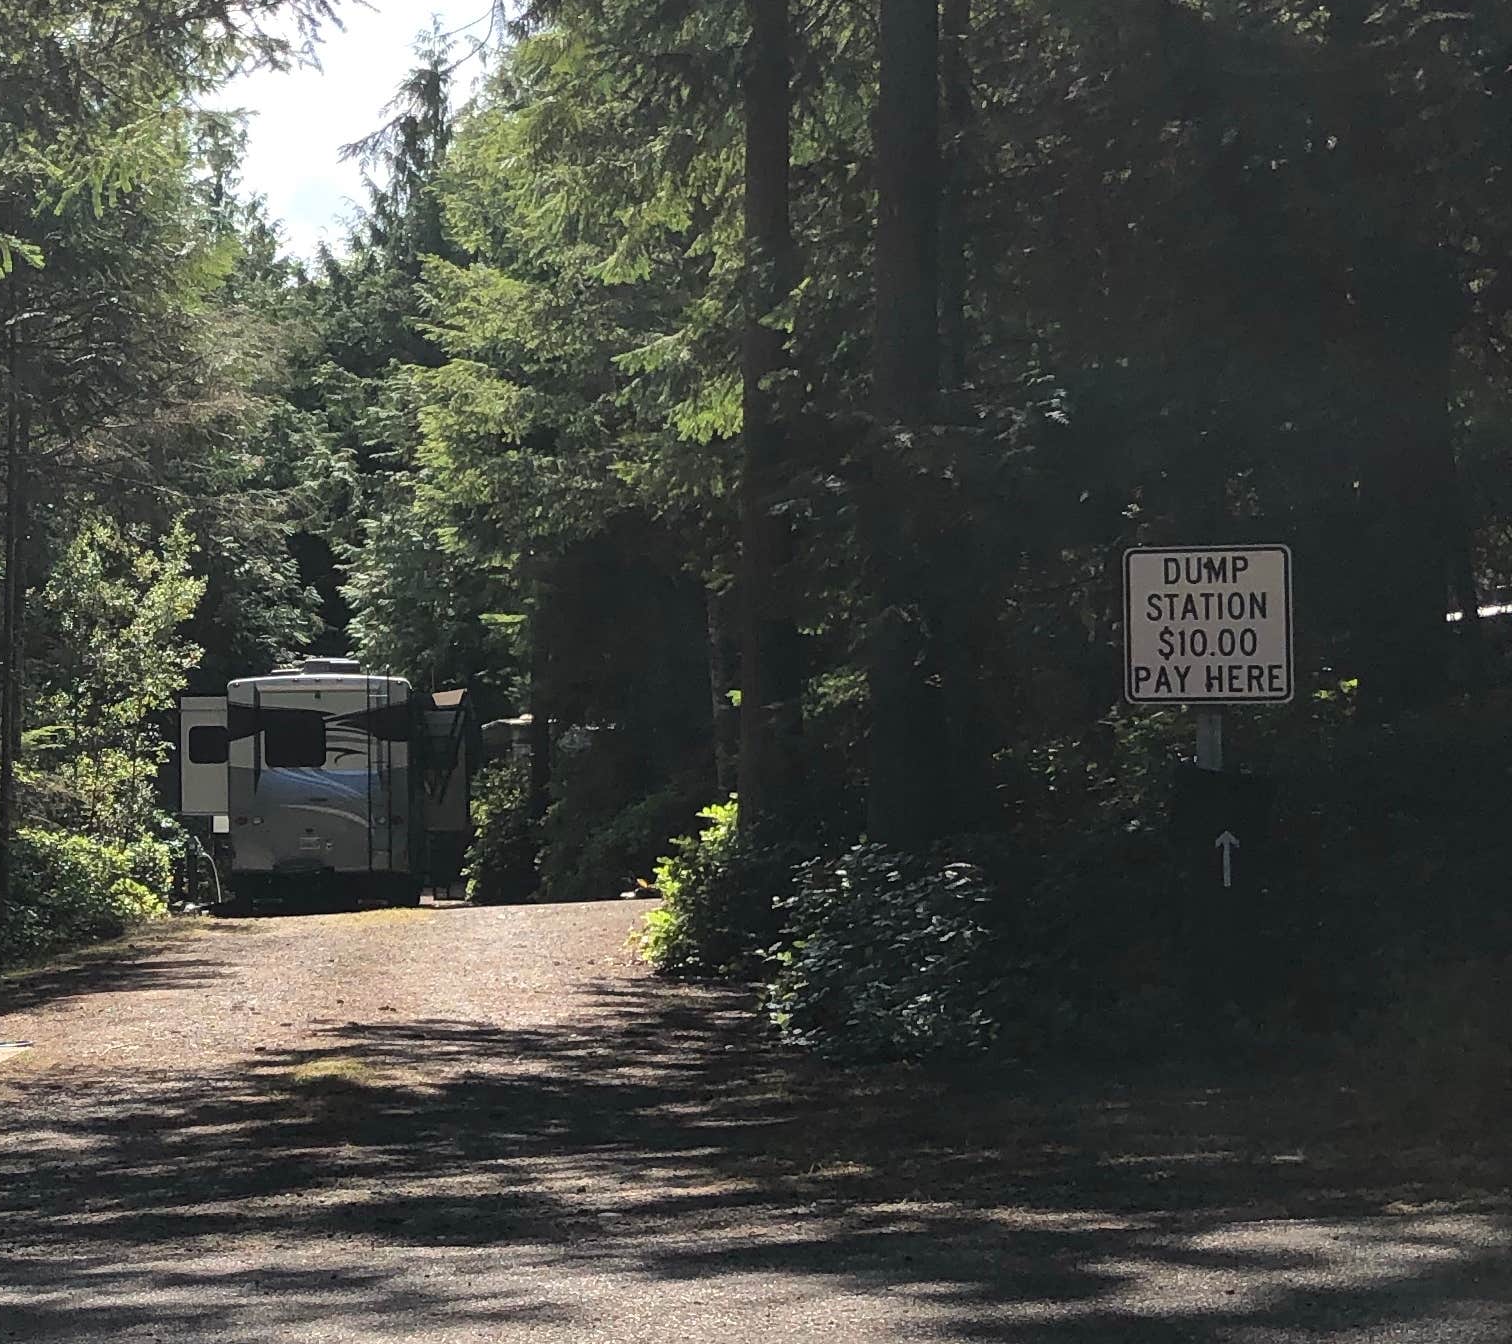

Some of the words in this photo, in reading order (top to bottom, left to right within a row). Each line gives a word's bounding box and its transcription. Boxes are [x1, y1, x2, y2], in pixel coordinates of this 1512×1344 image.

[1163, 556, 1249, 584] DUMP
[1146, 592, 1267, 621] STATION
[1158, 626, 1257, 661] $10.00
[1134, 665, 1192, 693] PAY
[1205, 665, 1284, 693] HERE
